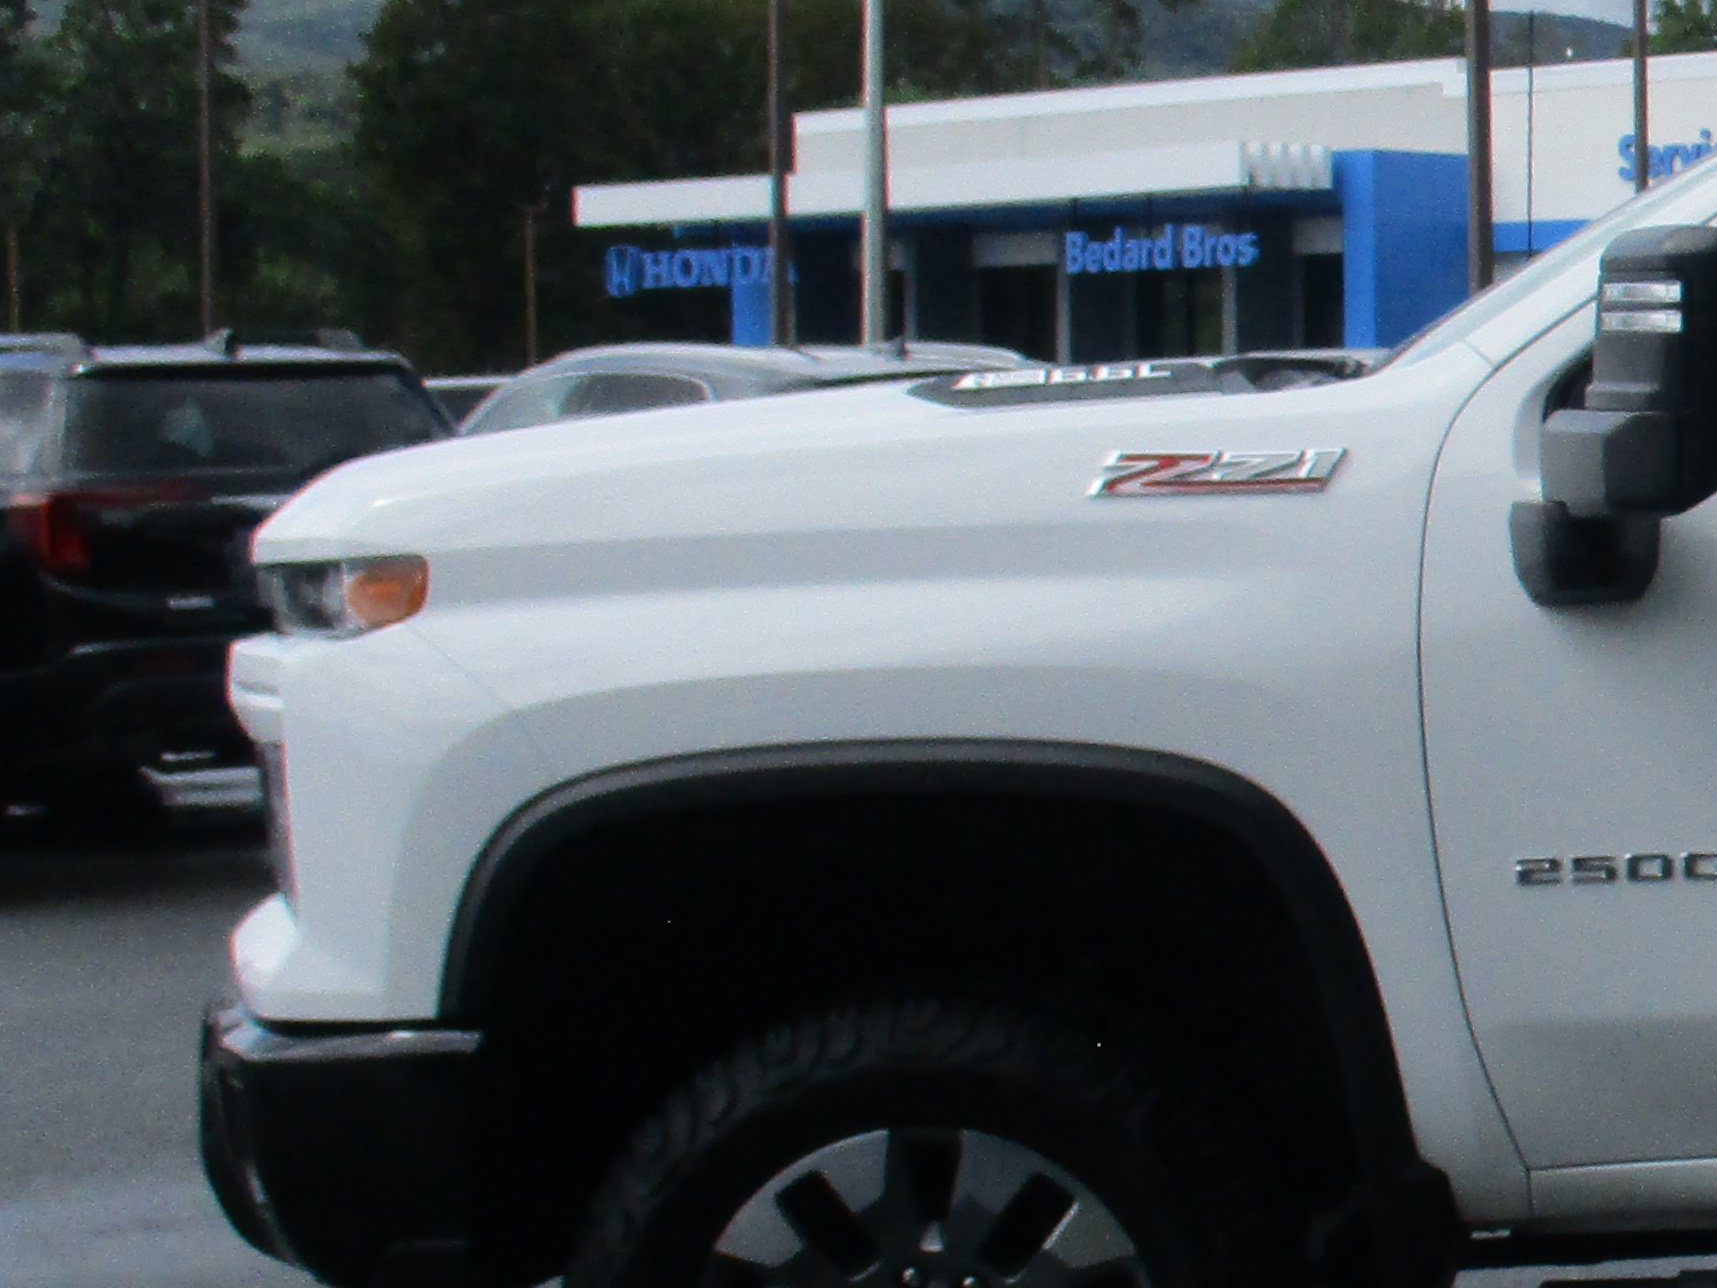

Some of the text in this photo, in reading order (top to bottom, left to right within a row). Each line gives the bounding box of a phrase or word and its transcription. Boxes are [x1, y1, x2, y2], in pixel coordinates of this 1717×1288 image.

[1065, 223, 1260, 274] Bedard Bros
[1085, 448, 1347, 497] Z71
